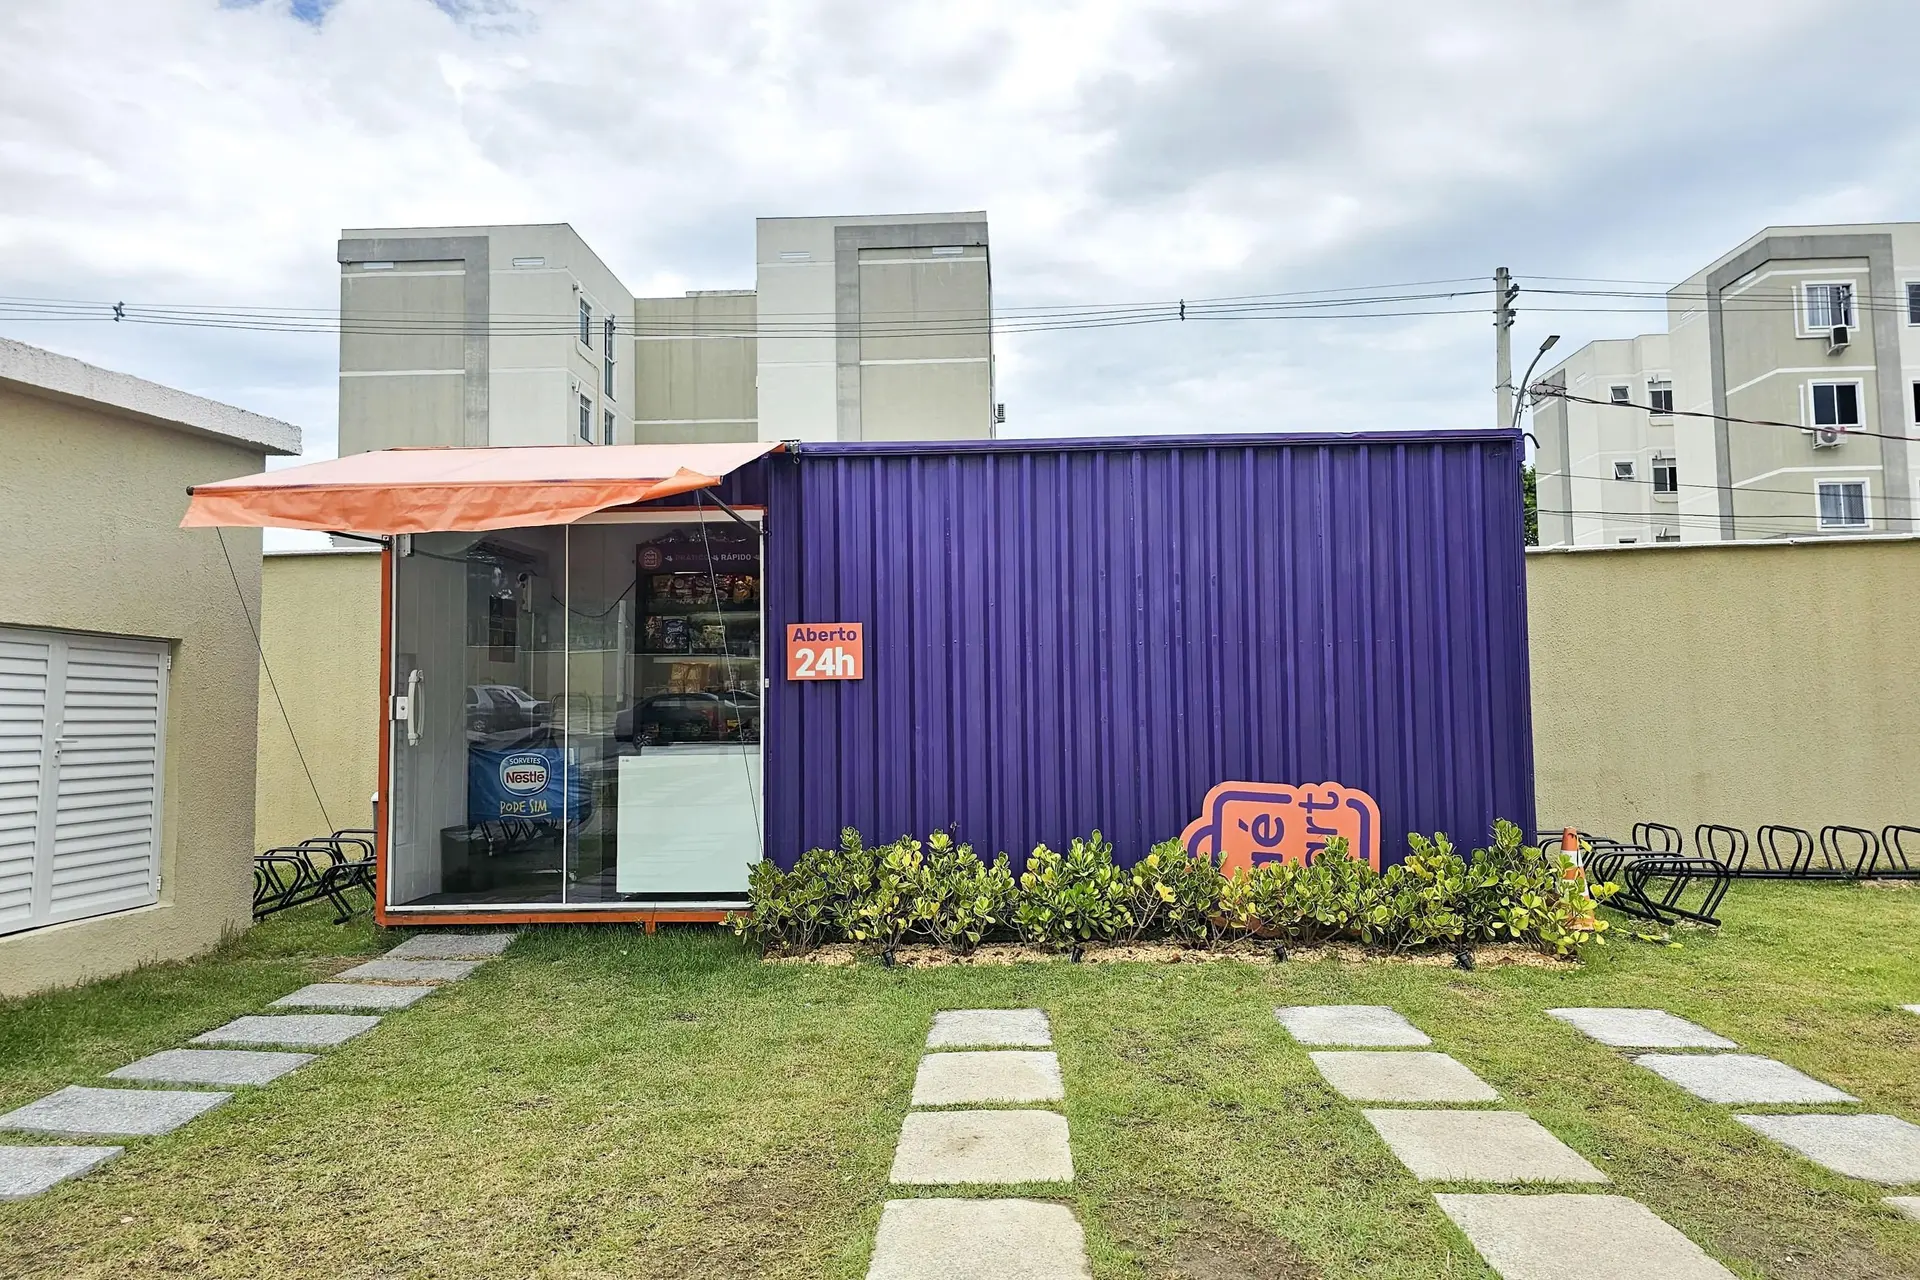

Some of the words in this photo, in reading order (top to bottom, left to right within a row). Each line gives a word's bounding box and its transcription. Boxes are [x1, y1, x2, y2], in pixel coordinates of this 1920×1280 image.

[720, 552, 752, 561] RÁPIDO
[793, 627, 857, 642] Aberto
[795, 646, 855, 677] 24h
[509, 757, 541, 765] SORVETES
[506, 771, 545, 783] Nestlé
[500, 800, 526, 814] PODE
[529, 799, 547, 813] SIM
